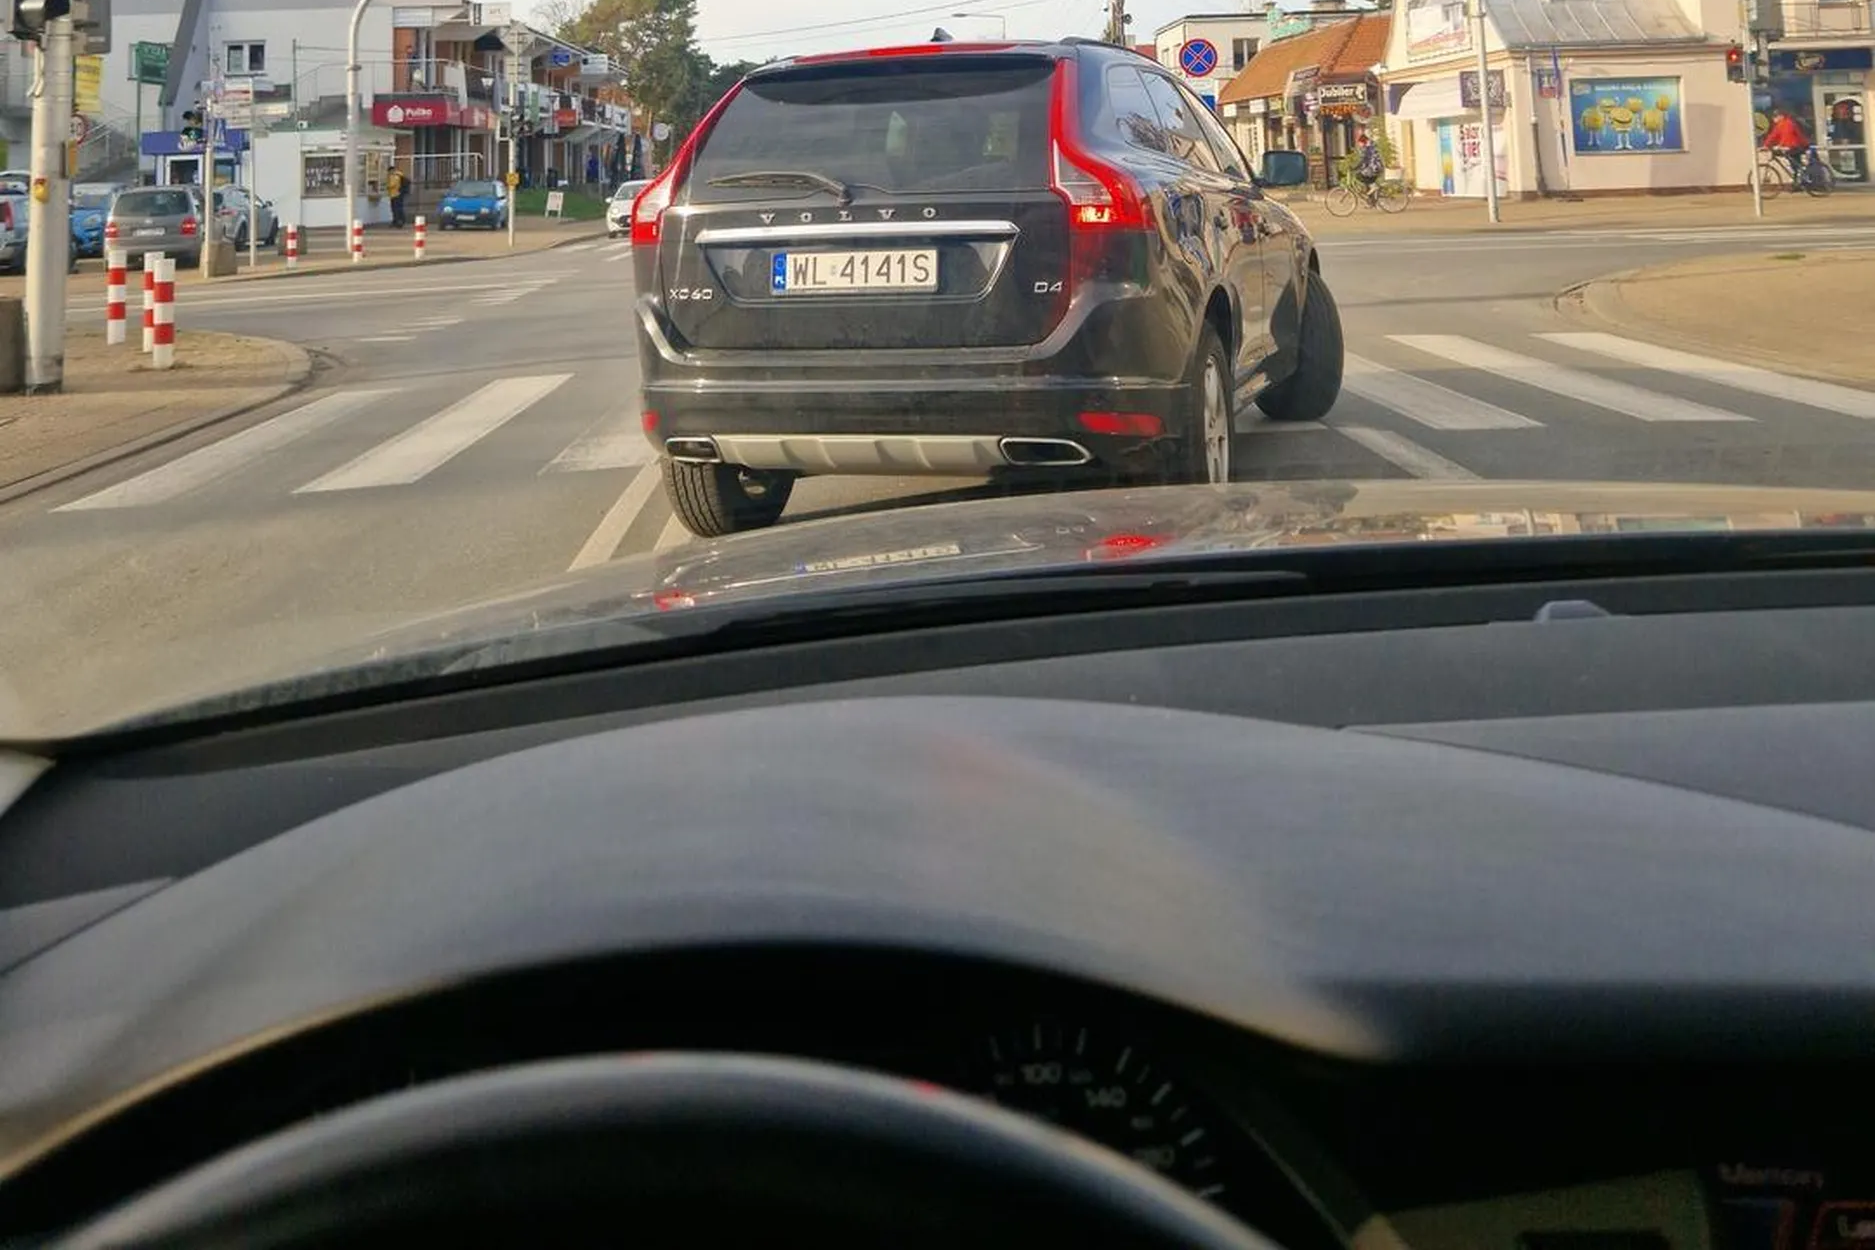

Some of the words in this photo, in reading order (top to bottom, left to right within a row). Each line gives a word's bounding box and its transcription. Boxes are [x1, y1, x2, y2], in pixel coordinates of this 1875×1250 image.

[760, 207, 937, 225] VOLVO
[793, 256, 827, 286] WL
[840, 253, 931, 285] 4141S
[669, 288, 713, 300] XC60
[1034, 280, 1063, 294] D4
